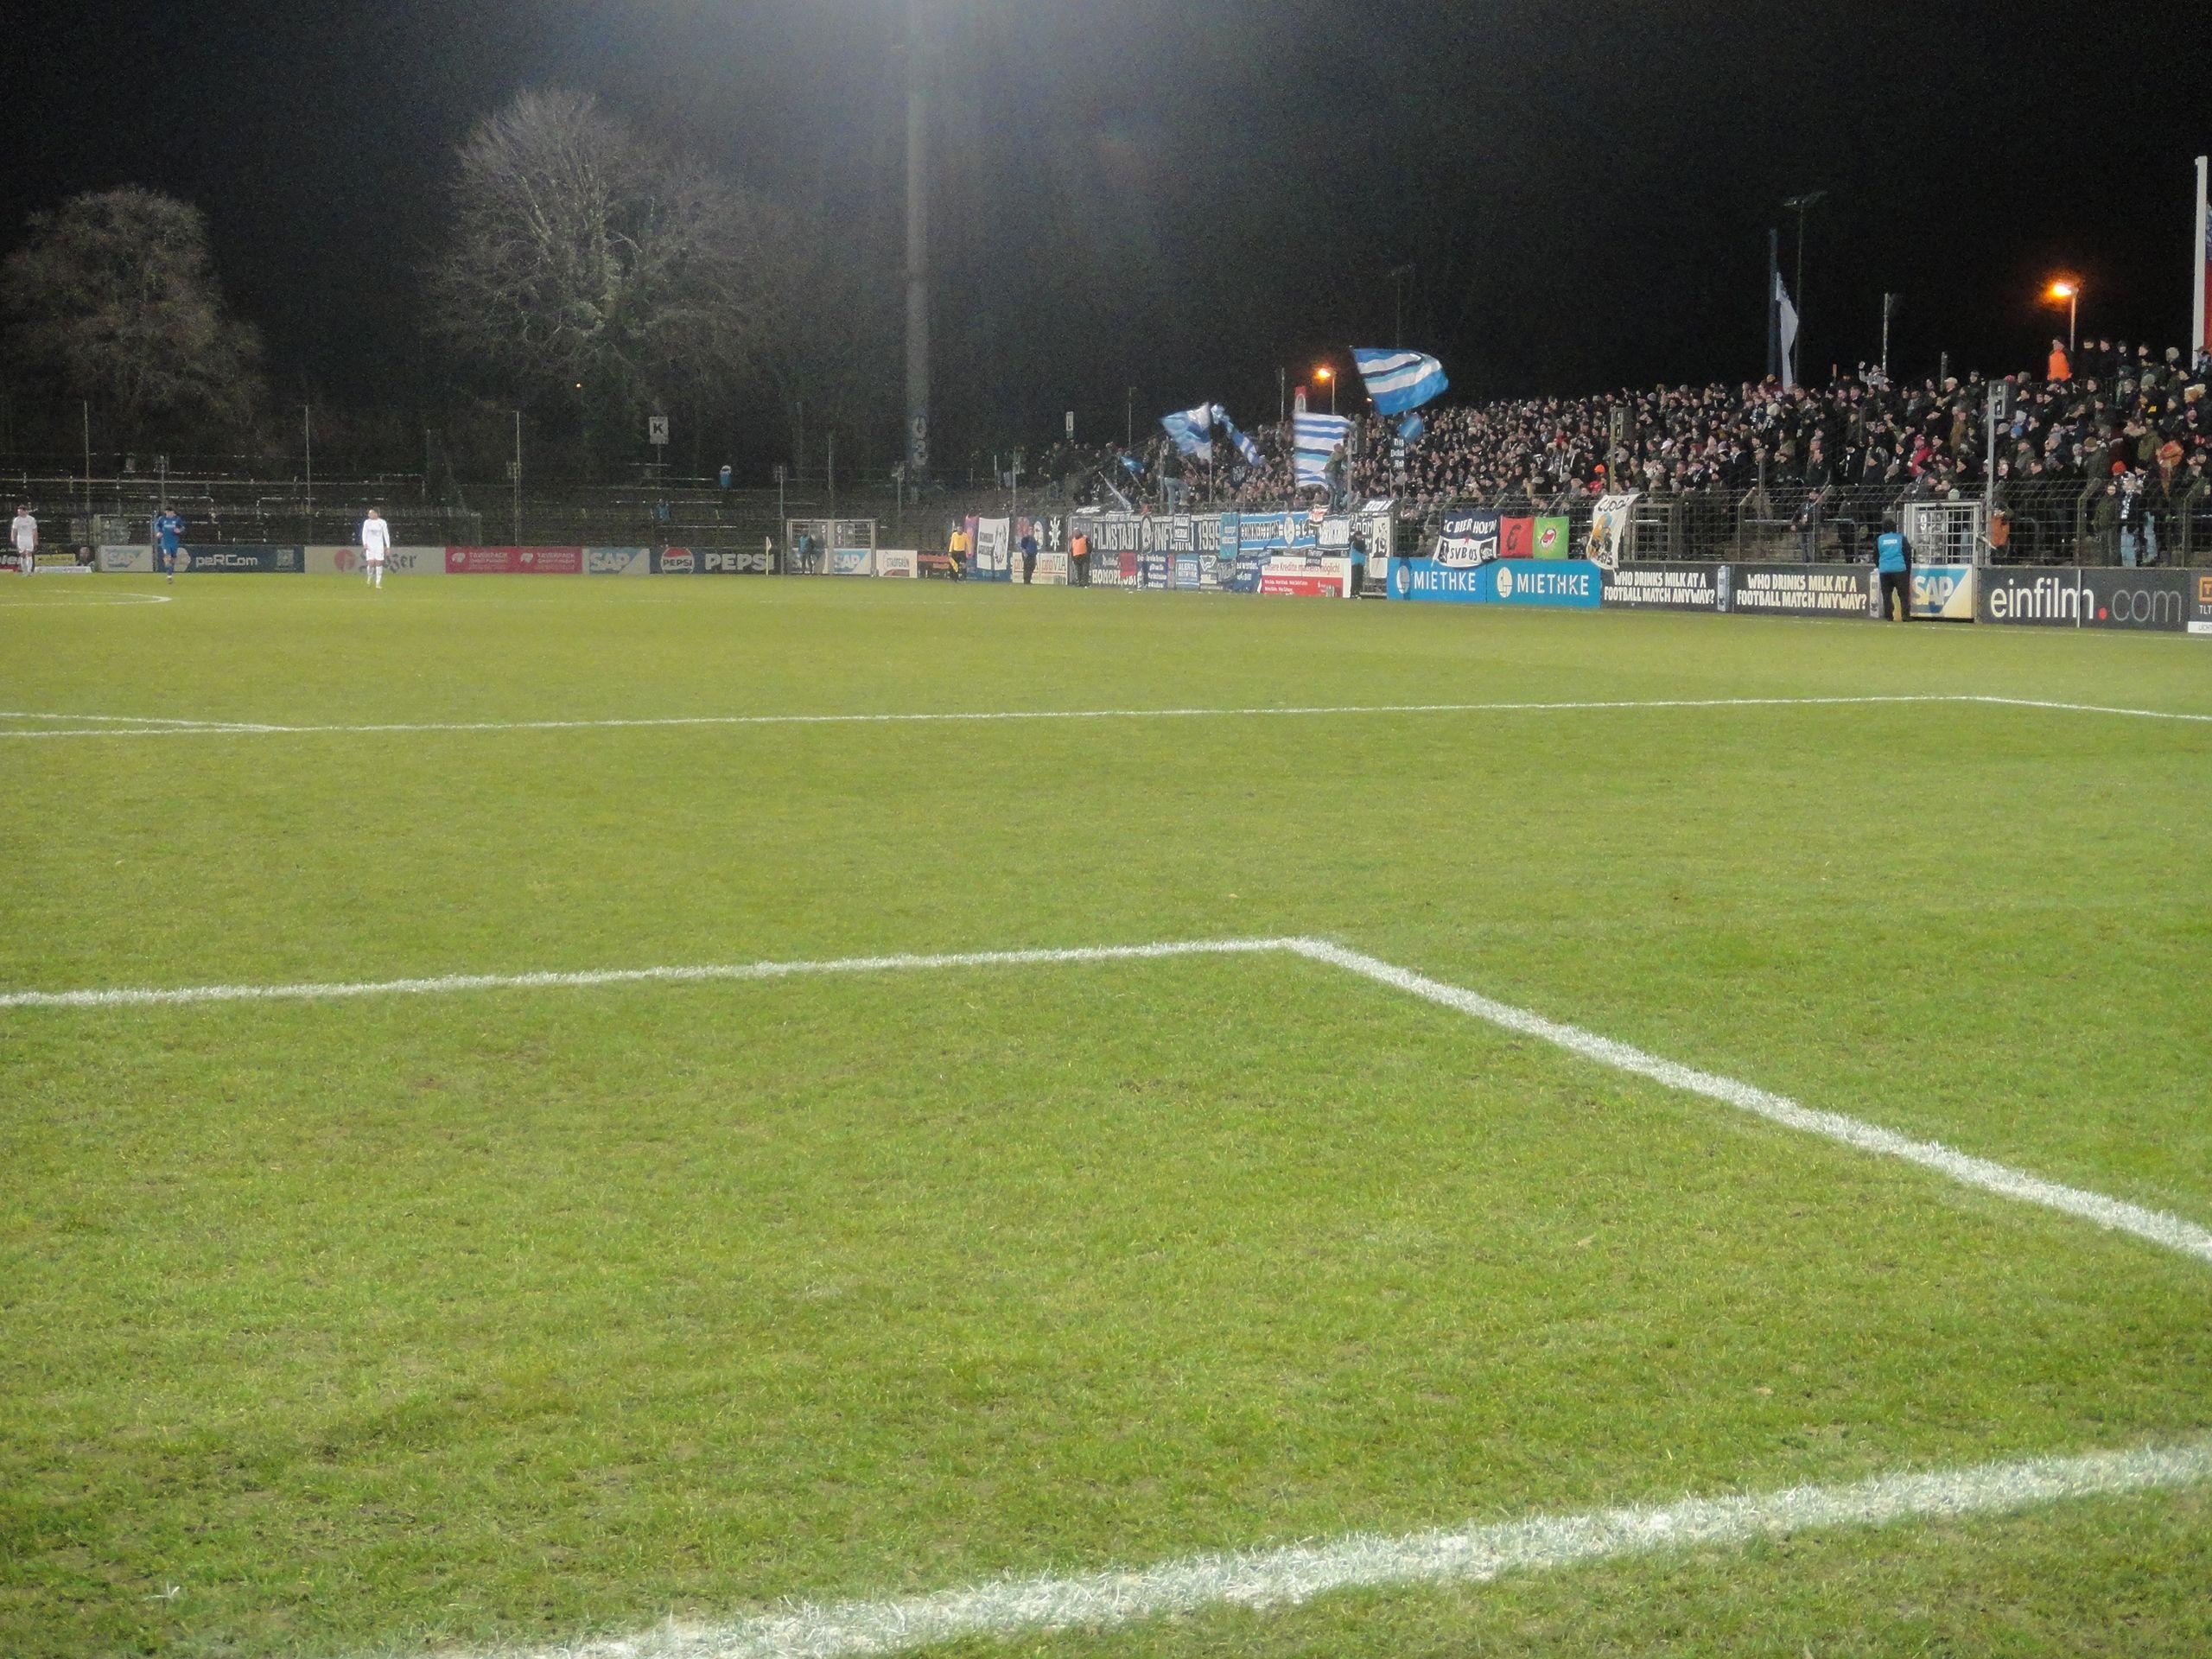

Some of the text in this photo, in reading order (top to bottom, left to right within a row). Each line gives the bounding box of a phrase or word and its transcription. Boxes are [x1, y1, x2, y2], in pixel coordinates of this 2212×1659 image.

[653, 423, 664, 434] K
[1453, 518, 1473, 533] BIER
[1092, 522, 1140, 551] FILMSTADT
[589, 551, 630, 571] SAP
[664, 558, 693, 567] PEPSI
[705, 553, 775, 571] PEPSI
[834, 553, 861, 569] SAP
[1450, 547, 1478, 561] SVB 03
[1414, 570, 1477, 592] MIETHKE
[1517, 573, 1590, 596] MIETHKE
[1614, 571, 1707, 588] WHO DRINKS MILK AT A
[1747, 574, 1857, 592] WHO DRINKS MILK AT A
[1605, 586, 1715, 604] FOOTBALL MATCH ANYWAY?
[1737, 589, 1867, 610] FOOTBALL MATCH ANYWAY?
[1913, 575, 1954, 606] SAP
[1990, 577, 2182, 623] einfilm.com
